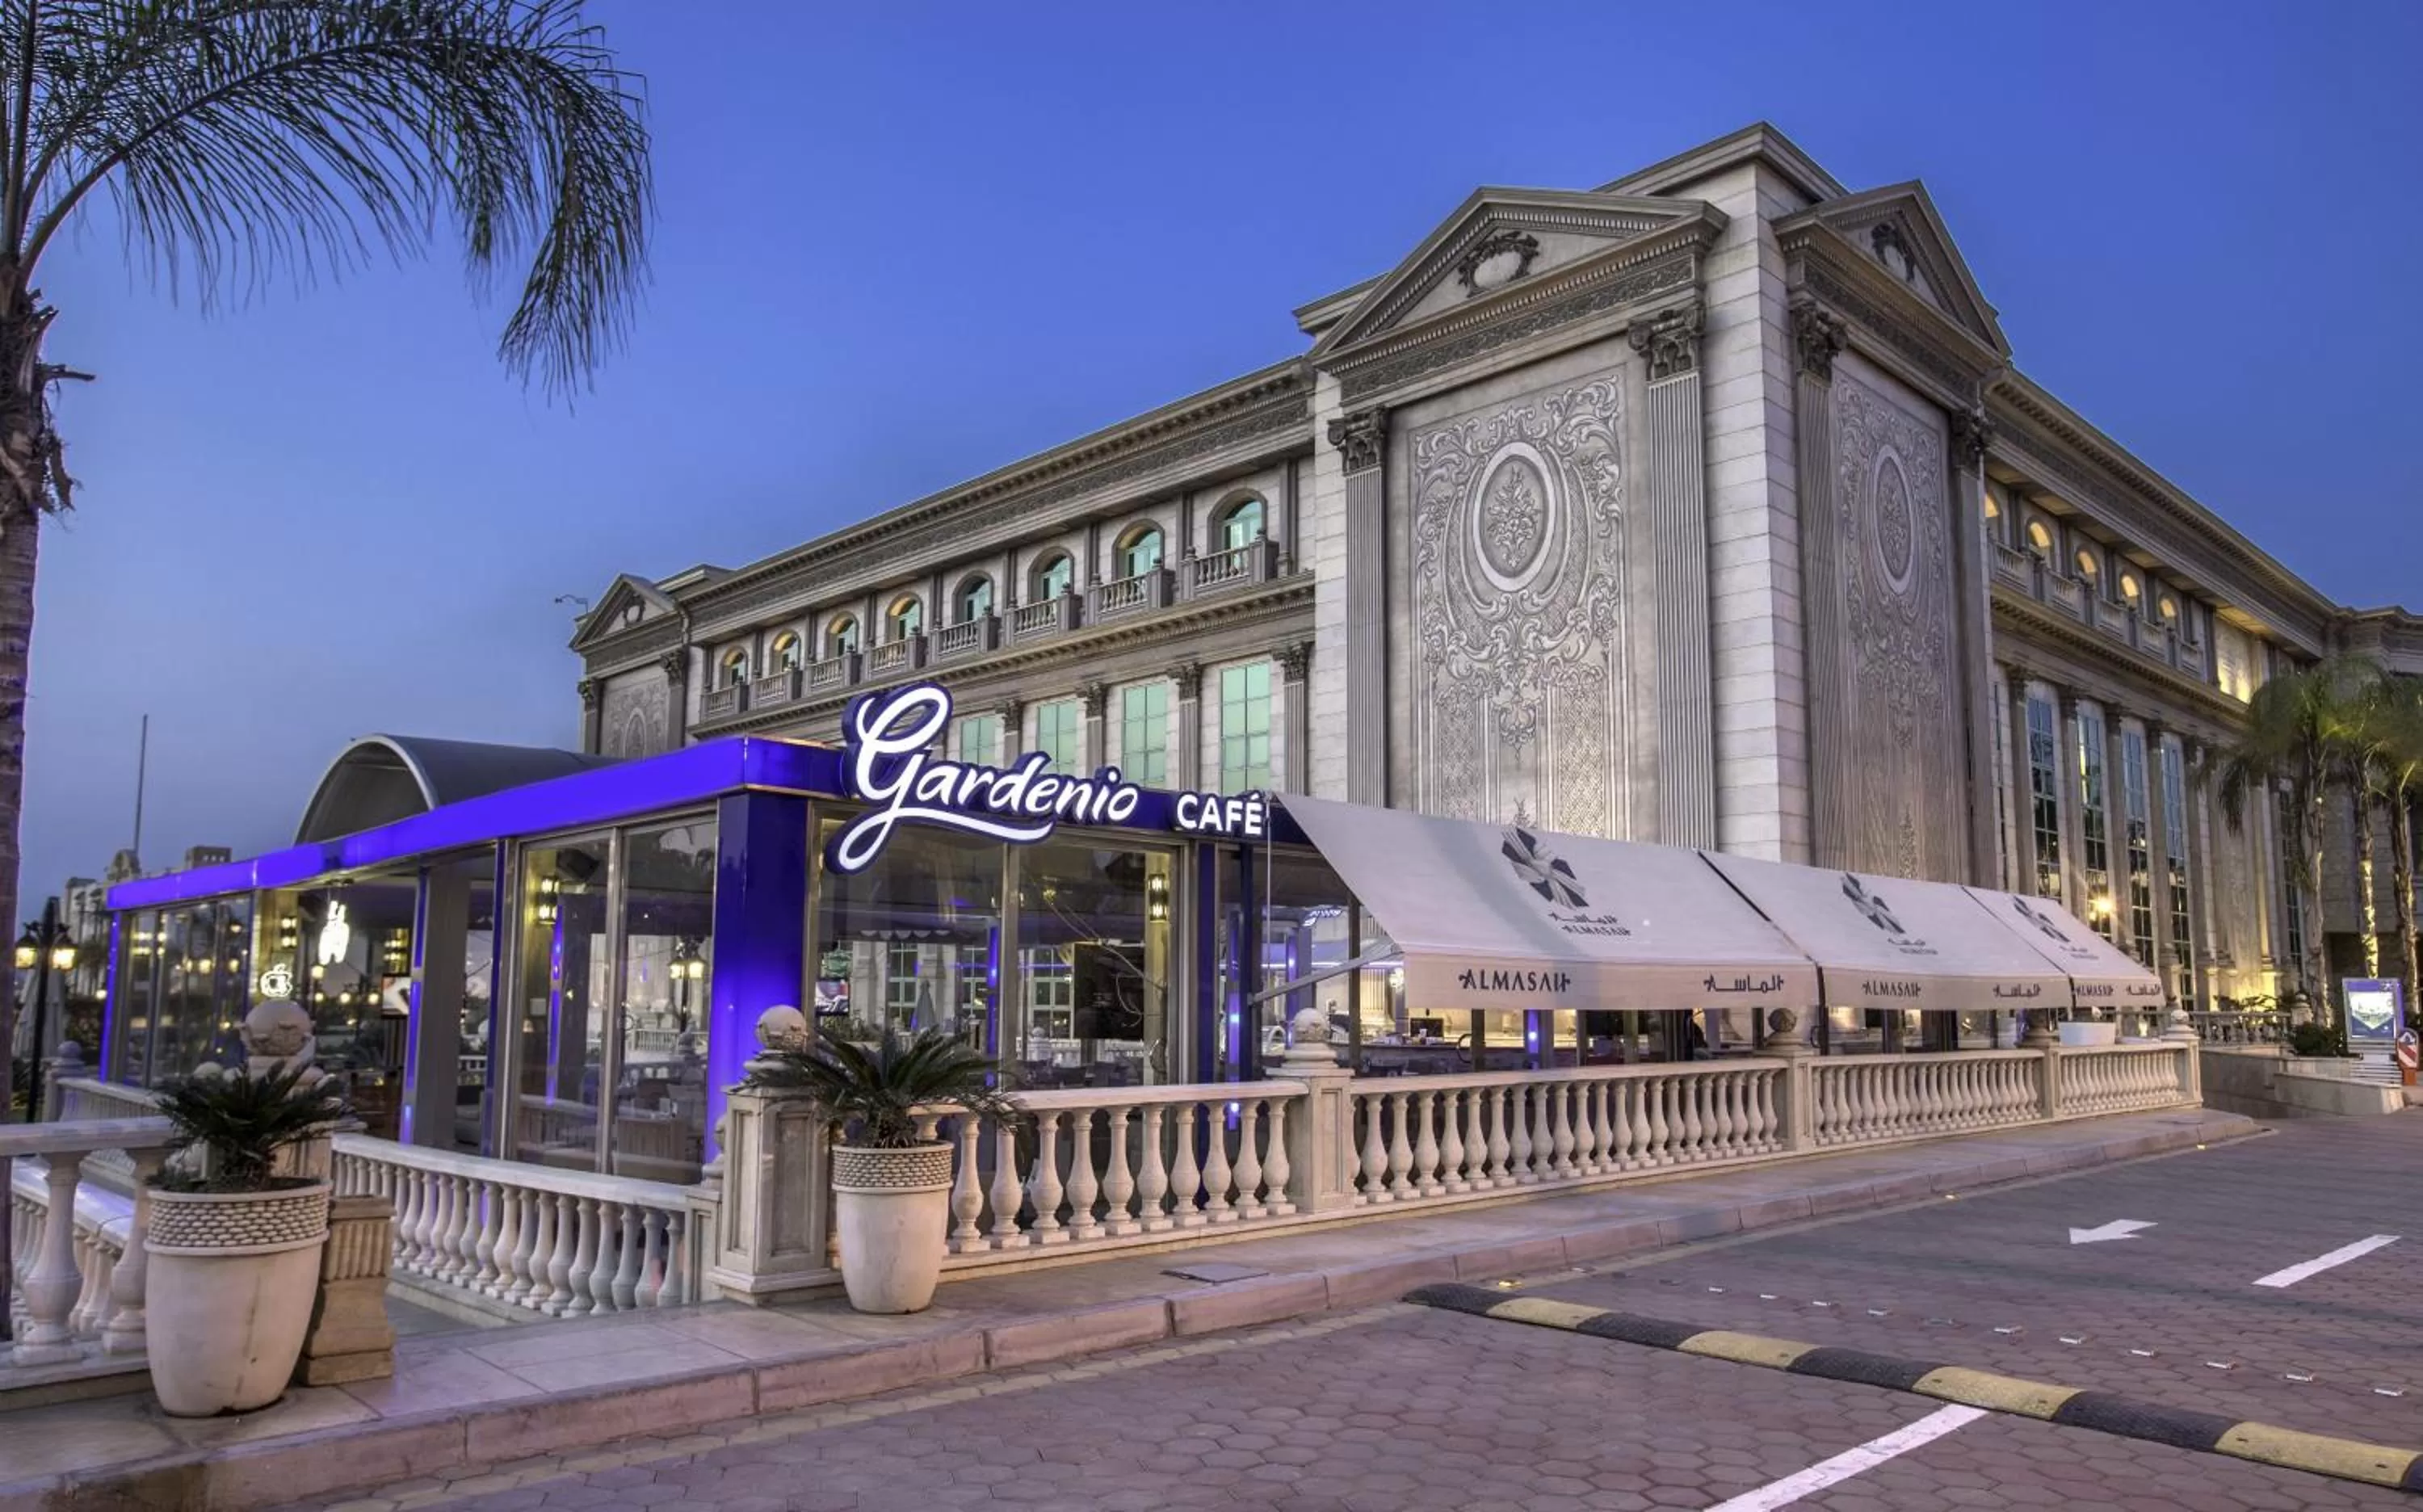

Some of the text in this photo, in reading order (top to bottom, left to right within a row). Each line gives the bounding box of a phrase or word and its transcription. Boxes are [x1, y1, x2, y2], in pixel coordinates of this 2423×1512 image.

[837, 685, 1263, 871] Gardenio CAFÉ
[1561, 925, 1631, 937] ALMASAH
[1458, 968, 1571, 993] ALMASAH
[1862, 979, 1921, 998] ALMASAH
